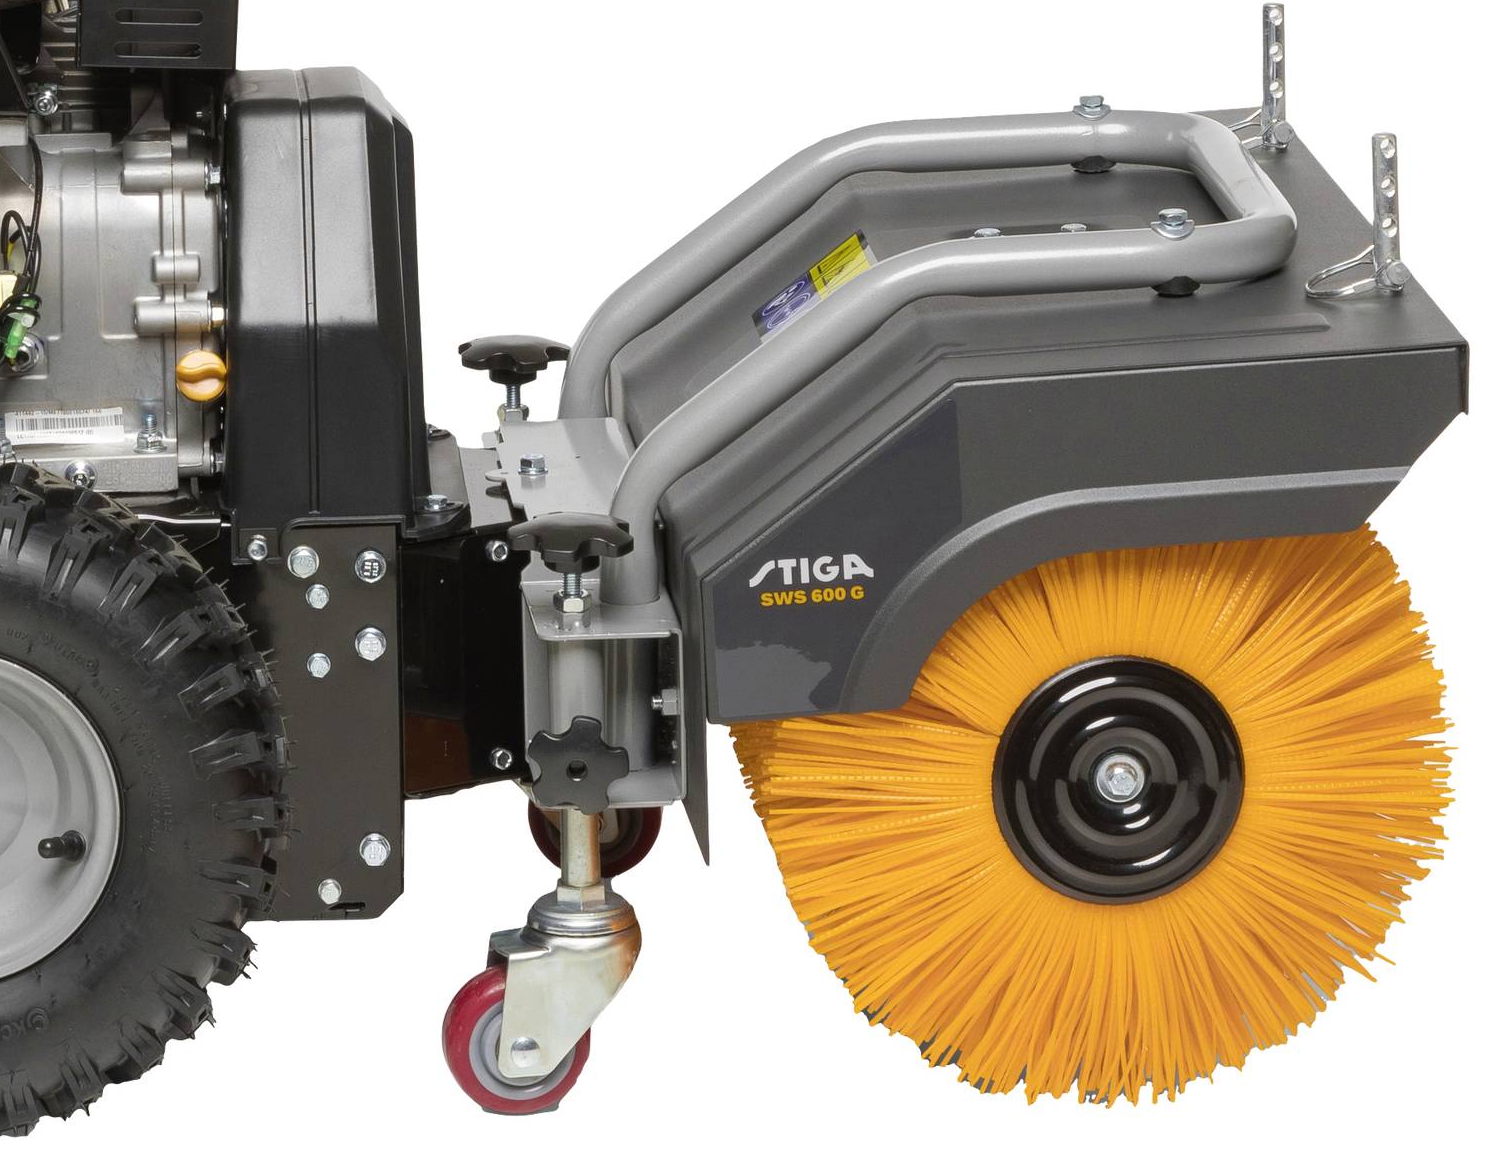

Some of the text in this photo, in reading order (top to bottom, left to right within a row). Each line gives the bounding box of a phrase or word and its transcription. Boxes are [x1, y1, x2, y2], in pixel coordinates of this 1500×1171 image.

[749, 554, 874, 587] STIGA
[760, 585, 865, 607] SWS 600 G
